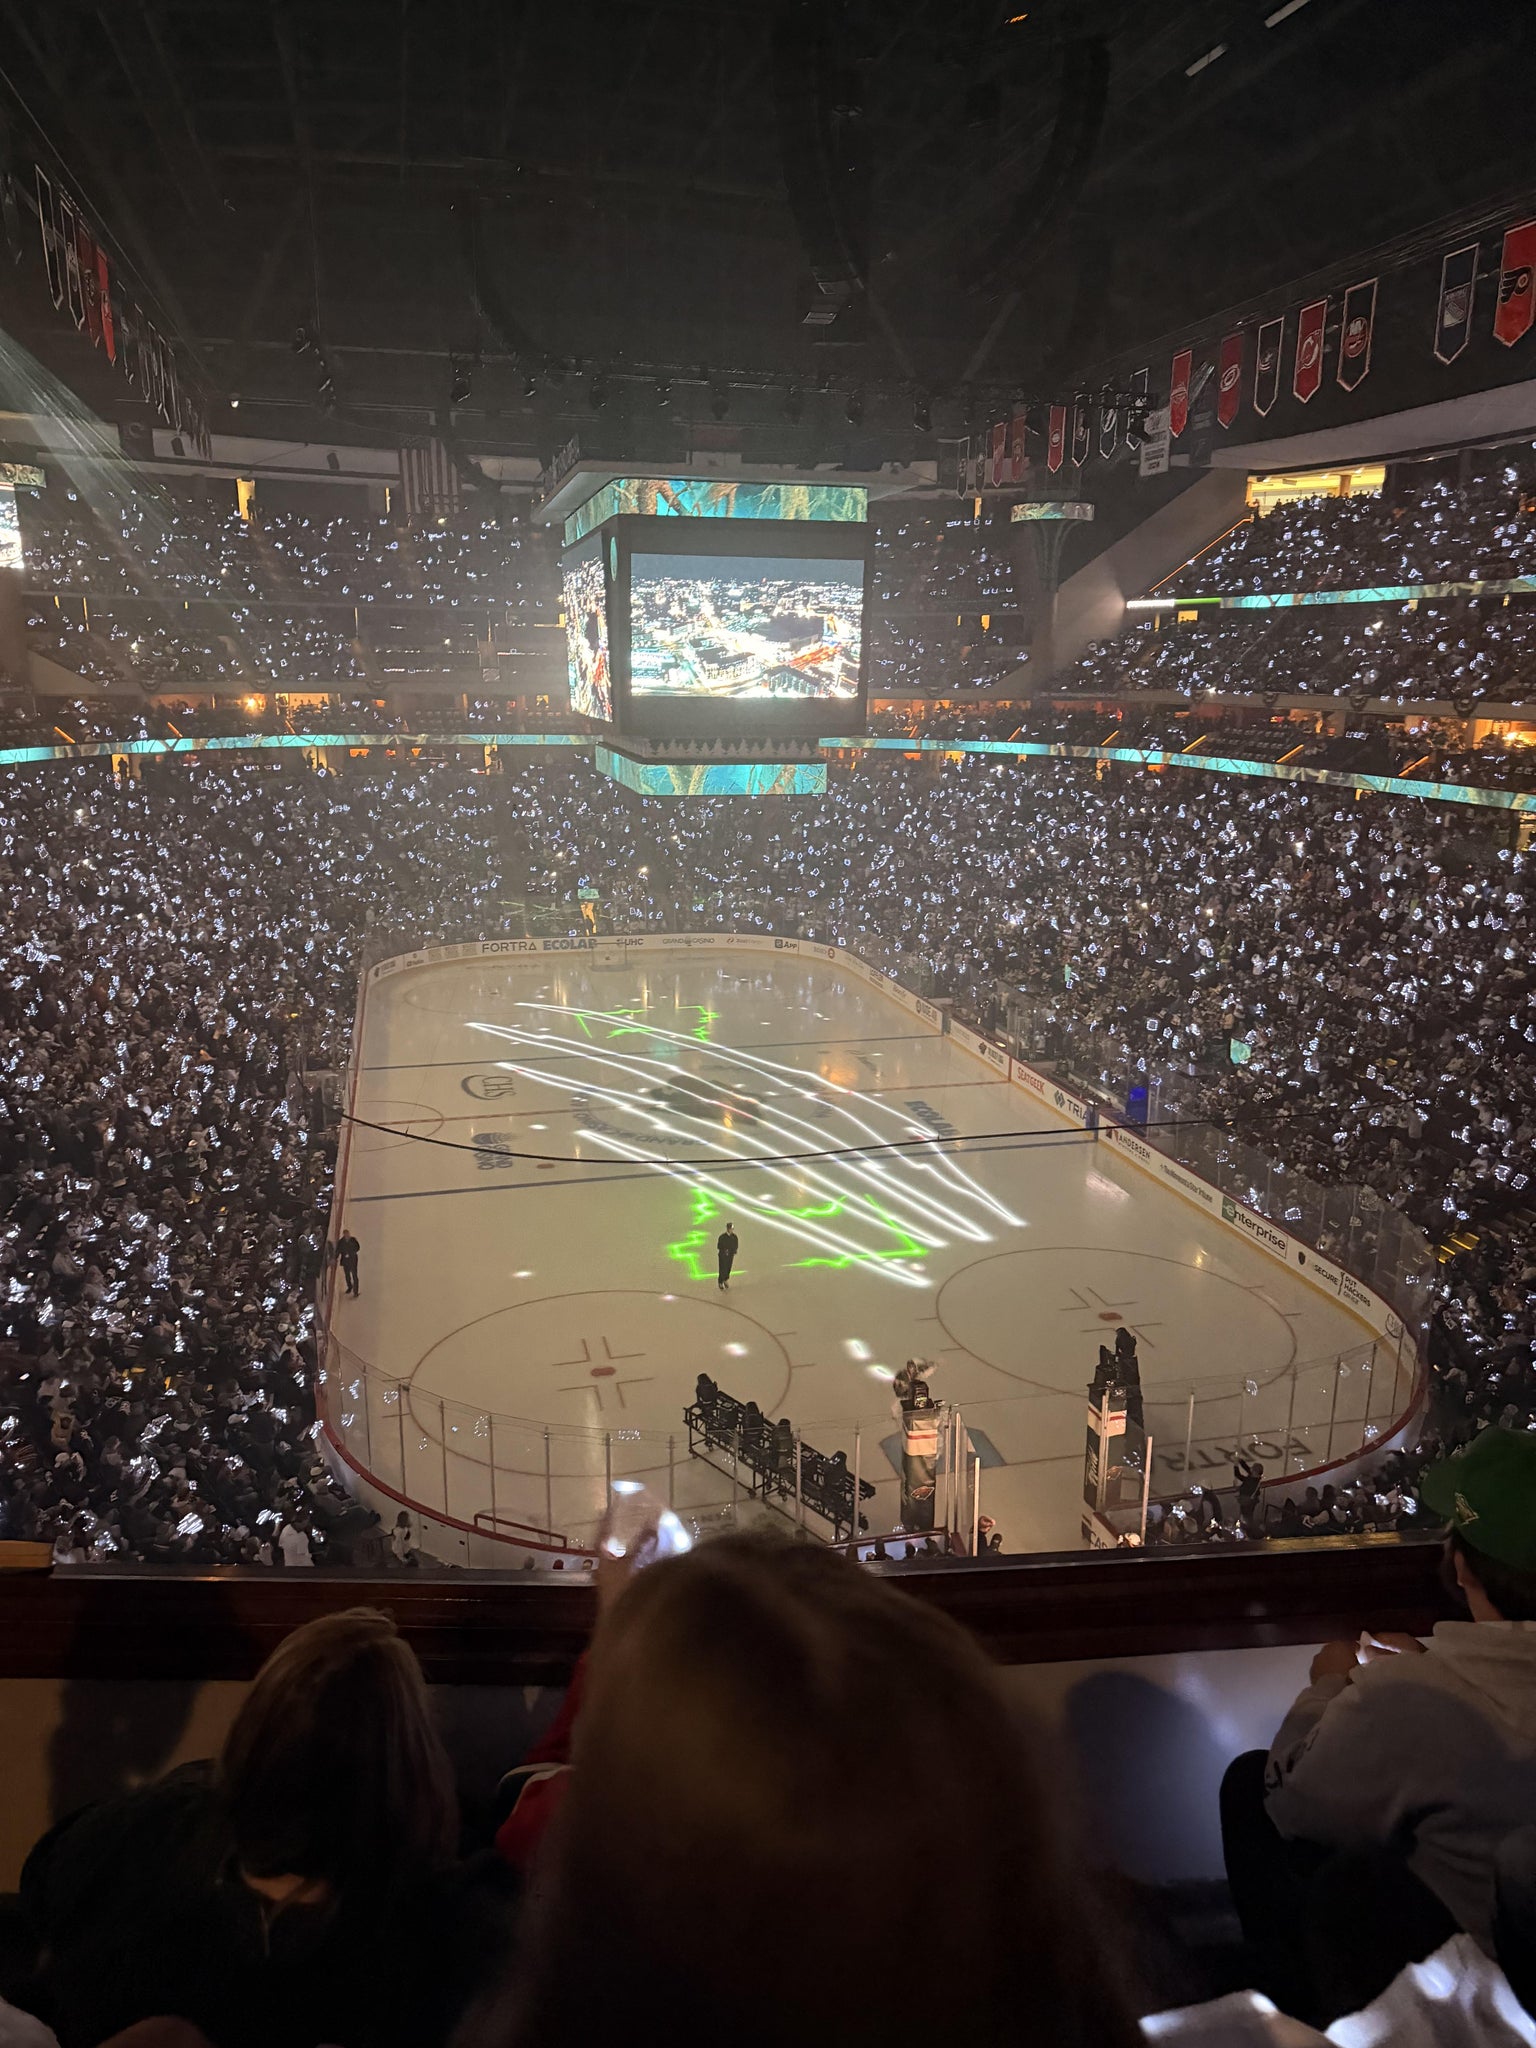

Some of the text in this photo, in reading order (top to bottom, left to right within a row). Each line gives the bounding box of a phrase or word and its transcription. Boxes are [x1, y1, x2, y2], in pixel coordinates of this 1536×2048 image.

[482, 941, 537, 953] FORTRA
[543, 938, 597, 951] ECOLAB
[625, 938, 644, 946] UHC
[1017, 1066, 1046, 1096] SEATGEEK
[1118, 1134, 1151, 1160] ANDERSEN
[1226, 1205, 1286, 1251] enterprise
[1158, 1436, 1312, 1472] FORTR
